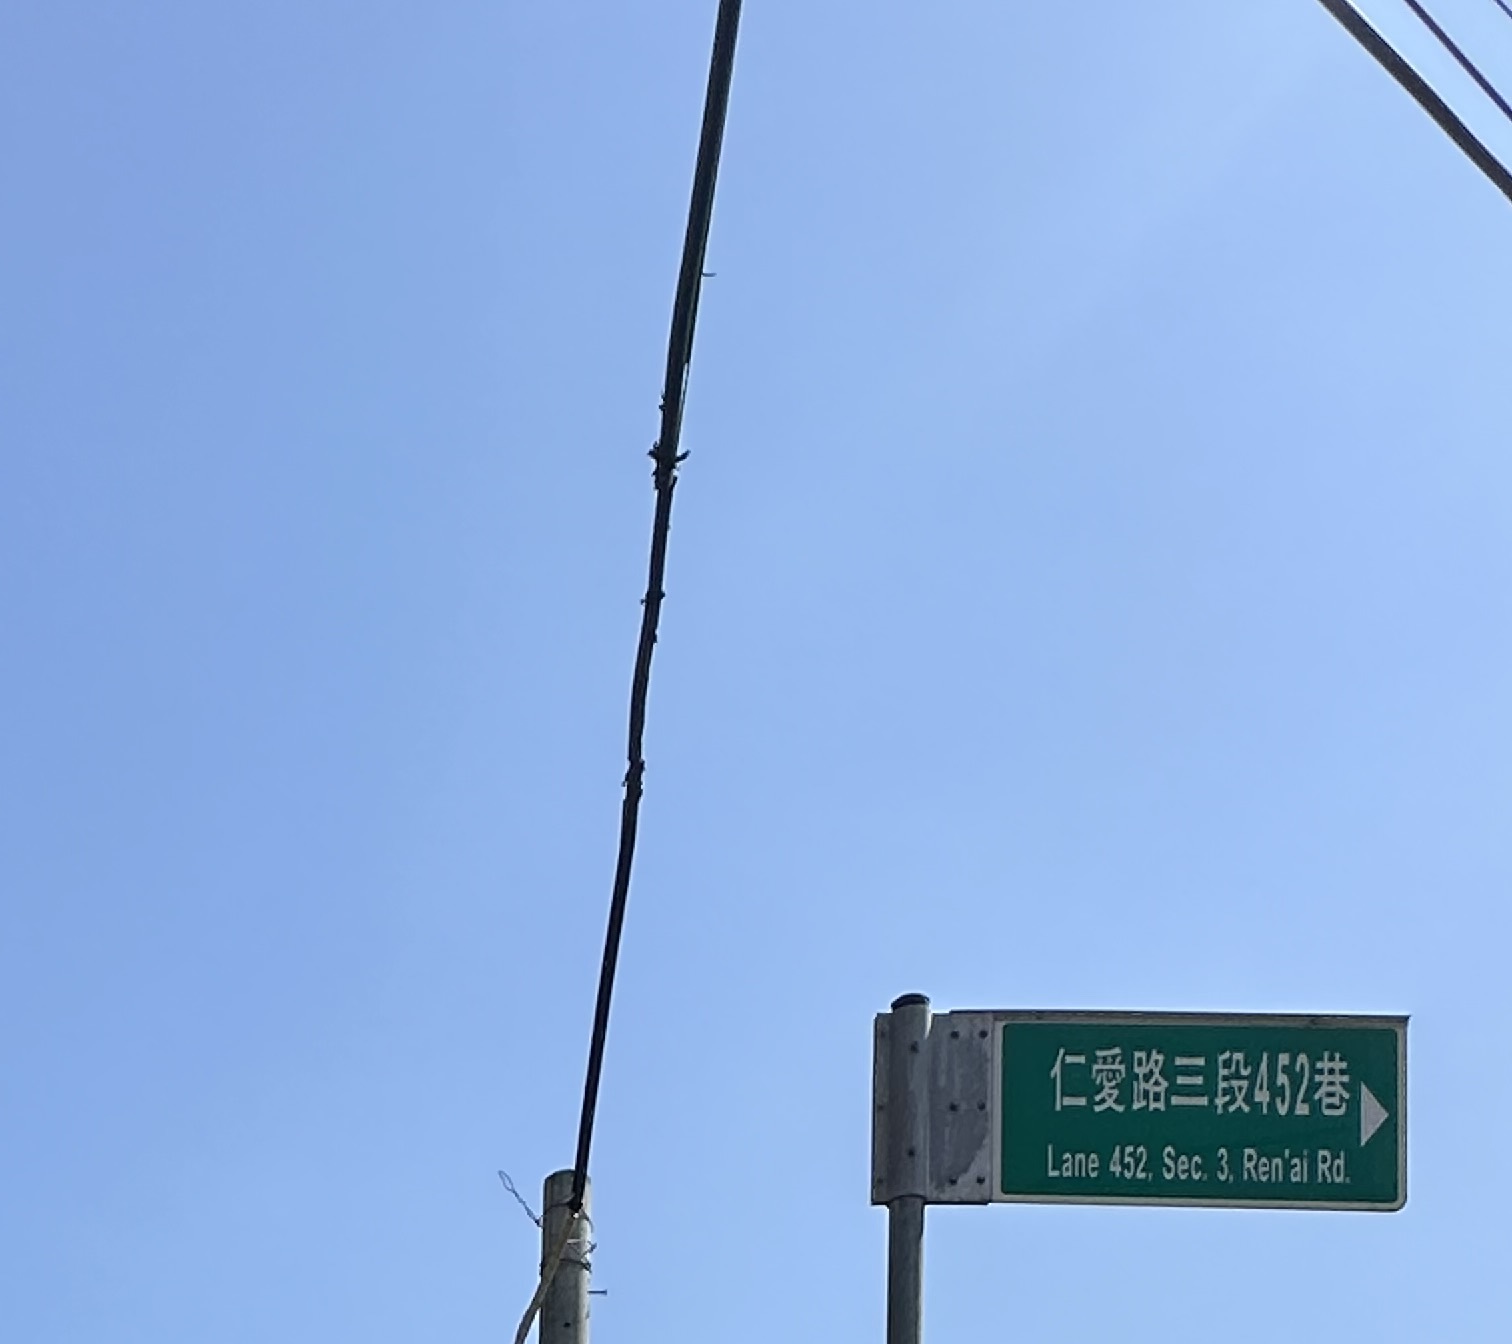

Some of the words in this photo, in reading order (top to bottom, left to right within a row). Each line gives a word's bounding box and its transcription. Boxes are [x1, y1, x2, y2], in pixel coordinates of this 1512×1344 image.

[1050, 1047, 1350, 1116] 仁愛路三段452巷
[1047, 1144, 1100, 1178] Lane
[1109, 1145, 1153, 1181] 452,
[1162, 1146, 1207, 1181] Sec.
[1243, 1148, 1308, 1183] Ren'ai
[1317, 1149, 1351, 1183] Rd.
